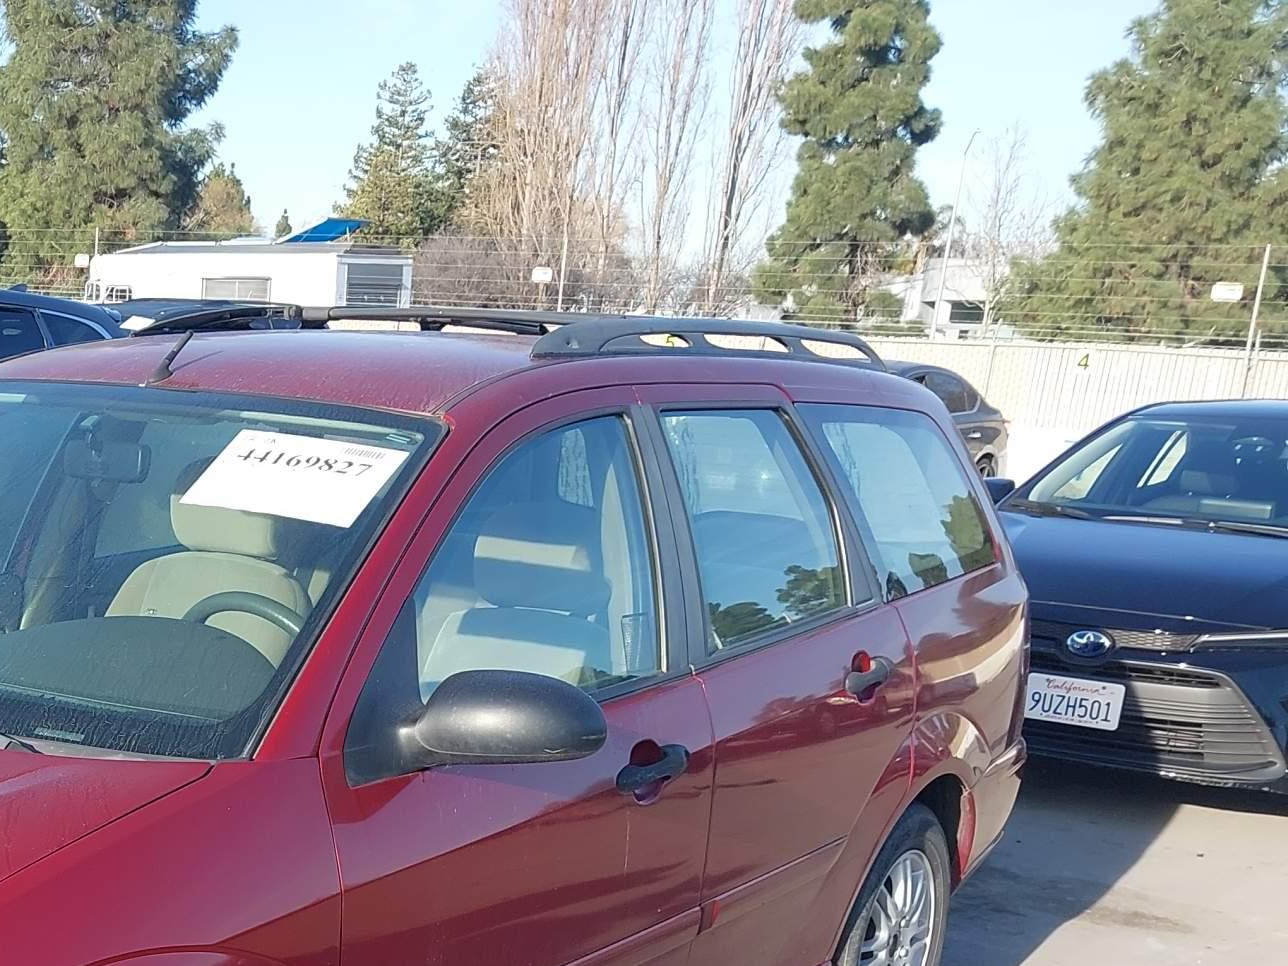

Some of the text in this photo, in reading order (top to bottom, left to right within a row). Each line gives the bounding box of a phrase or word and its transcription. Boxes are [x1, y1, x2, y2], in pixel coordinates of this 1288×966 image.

[1077, 353, 1090, 370] 4
[237, 448, 373, 477] 44169827
[1046, 679, 1103, 695] California
[1028, 691, 1111, 722] 9UZH501
